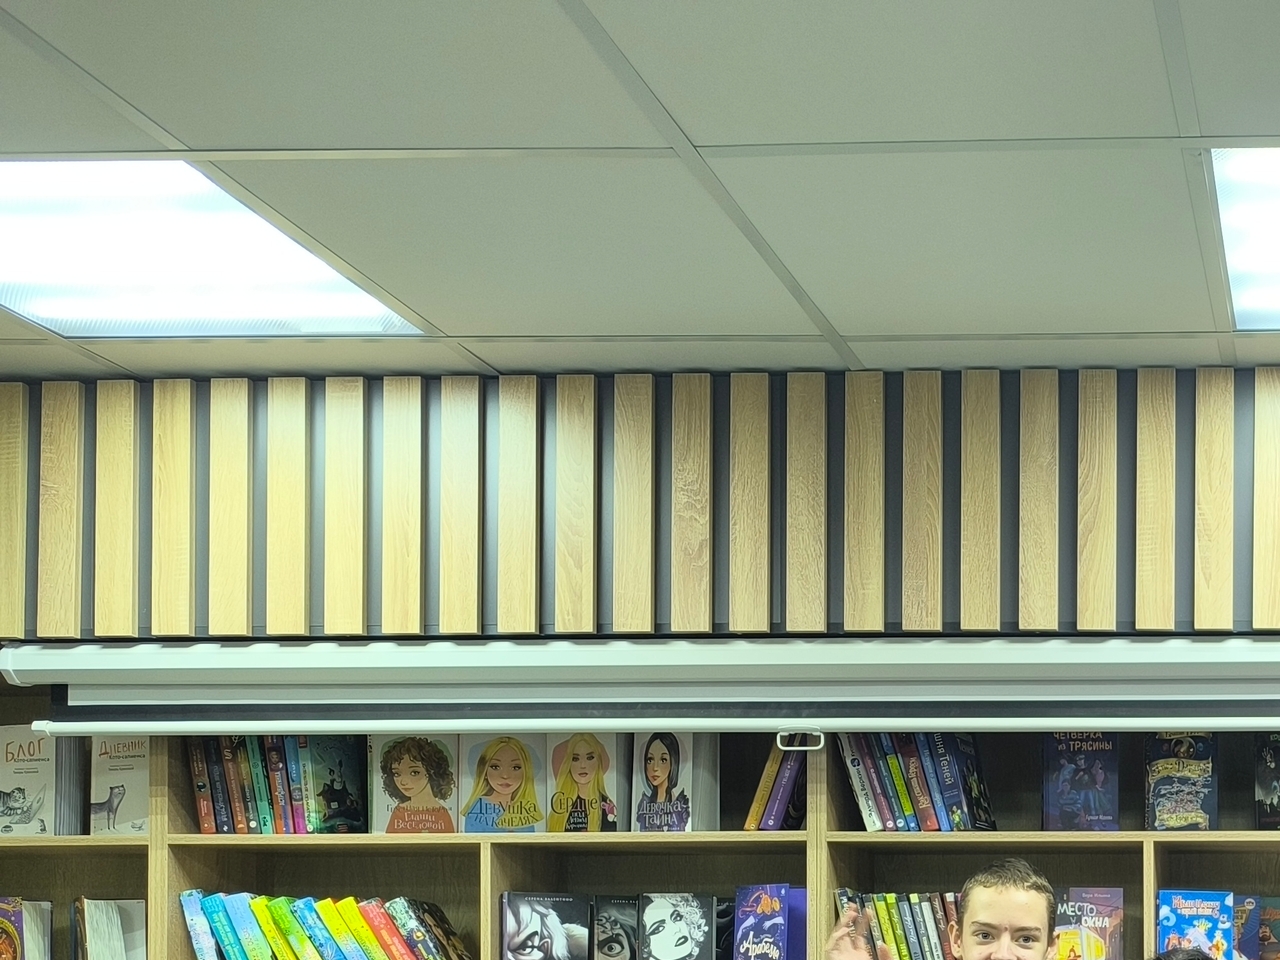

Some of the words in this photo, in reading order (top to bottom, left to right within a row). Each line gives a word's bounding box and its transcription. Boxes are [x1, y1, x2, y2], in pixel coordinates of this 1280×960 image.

[6, 738, 45, 762] БЛОГ
[99, 740, 146, 757] ДНЕВНИК
[1069, 741, 1112, 751] ТРЯСИНЫ
[939, 754, 954, 785] Теней
[1057, 902, 1096, 916] МЕСТО
[1081, 916, 1110, 928] ОКНА
